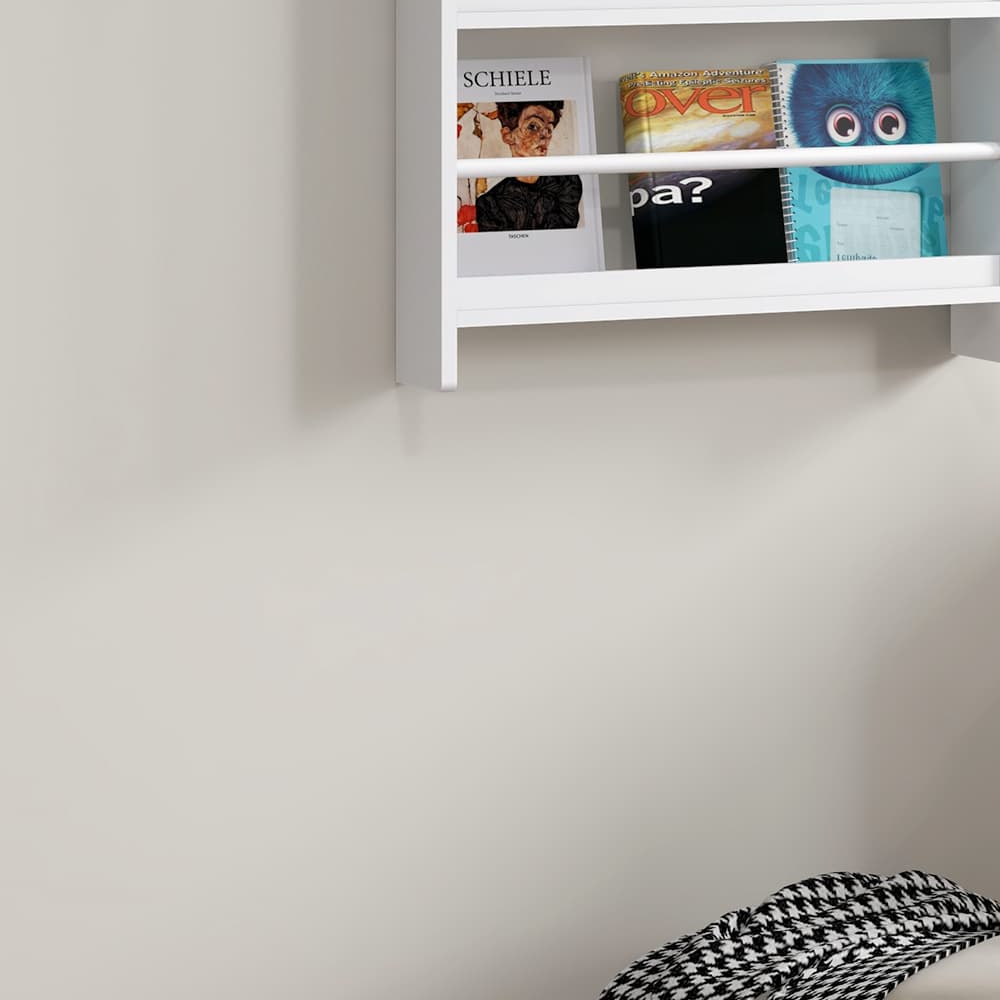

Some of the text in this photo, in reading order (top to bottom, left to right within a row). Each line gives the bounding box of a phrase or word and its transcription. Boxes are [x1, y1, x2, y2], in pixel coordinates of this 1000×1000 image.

[462, 69, 552, 88] SCHIELE
[649, 70, 698, 79] Amazon
[702, 68, 764, 78] Adventure
[624, 85, 768, 119] over
[629, 175, 713, 216] pa?
